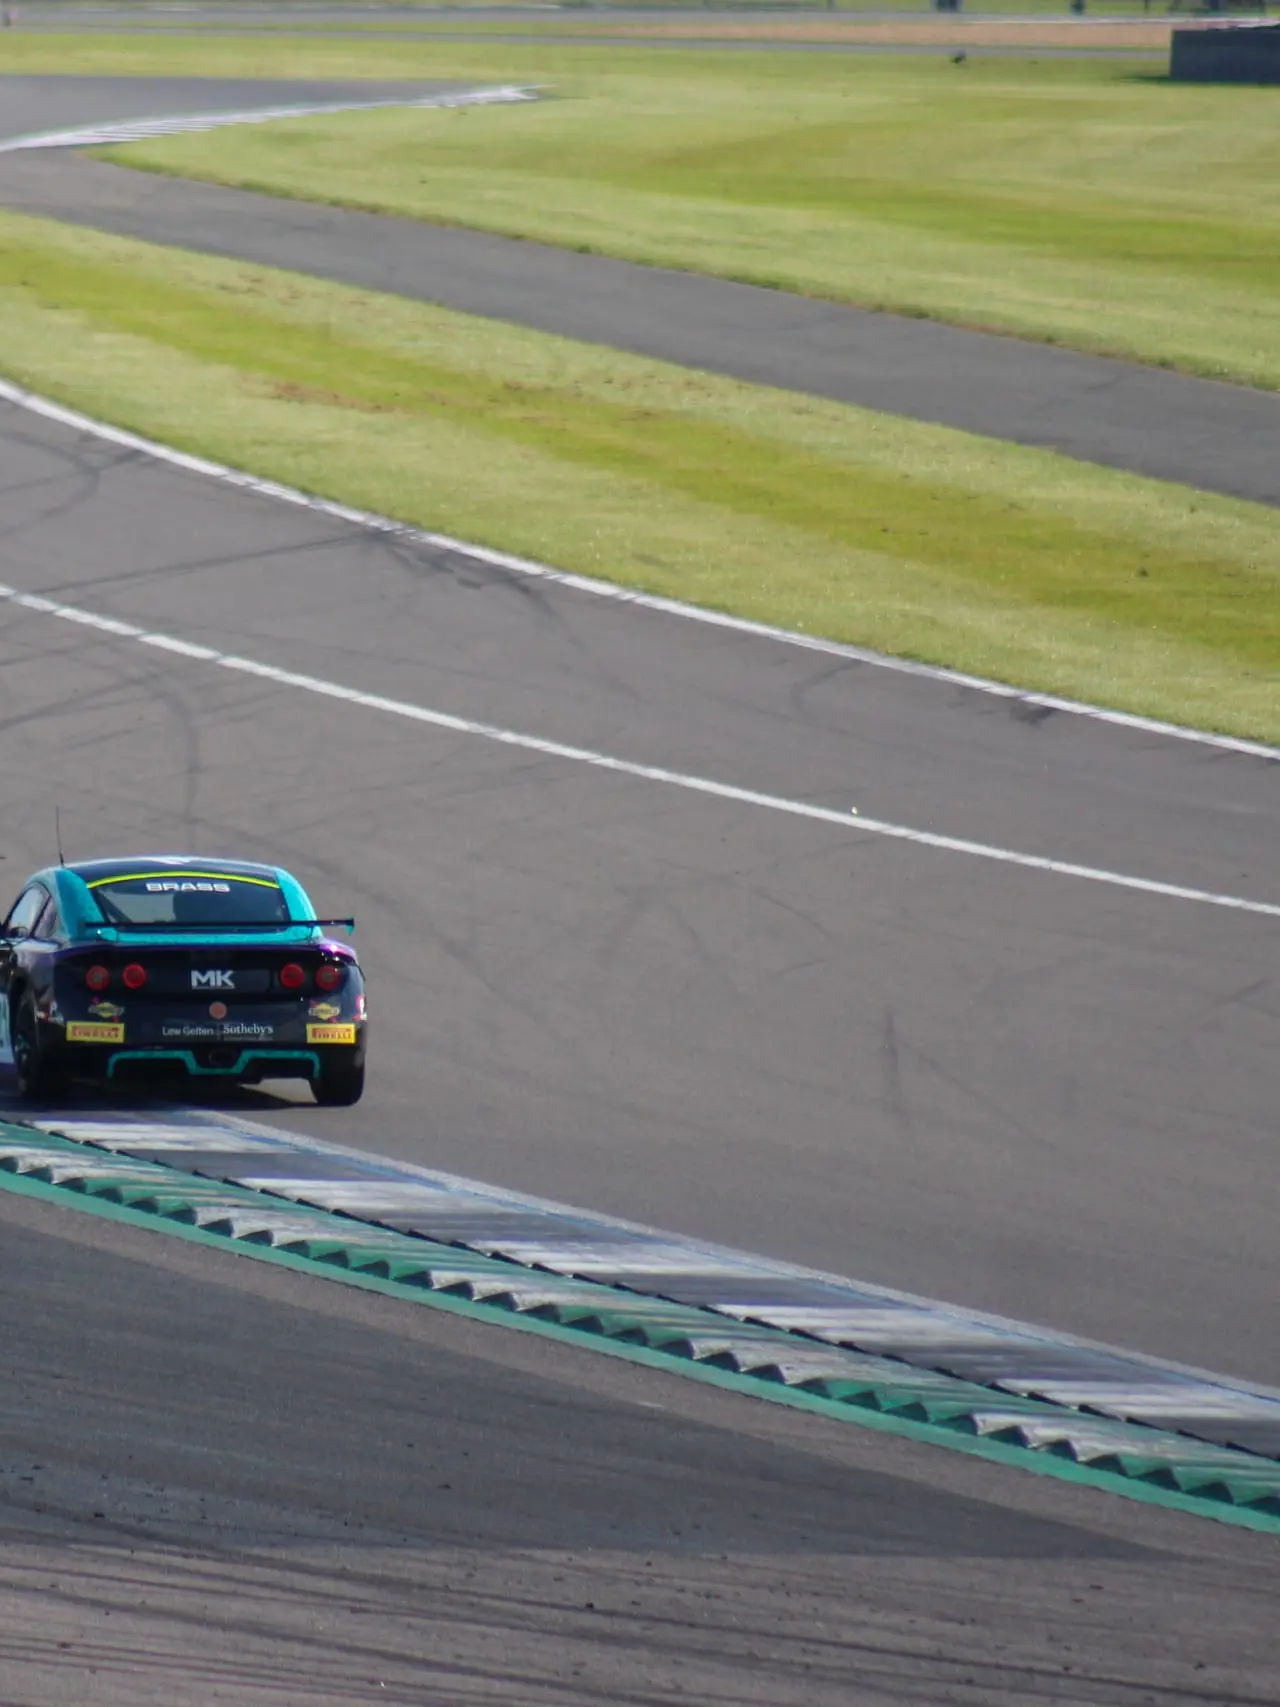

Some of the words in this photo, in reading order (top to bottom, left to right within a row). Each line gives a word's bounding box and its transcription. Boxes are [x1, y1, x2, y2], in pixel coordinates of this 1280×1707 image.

[145, 882, 230, 892] BRASS
[190, 969, 235, 989] MK
[223, 1023, 274, 1037] Sotheby's
